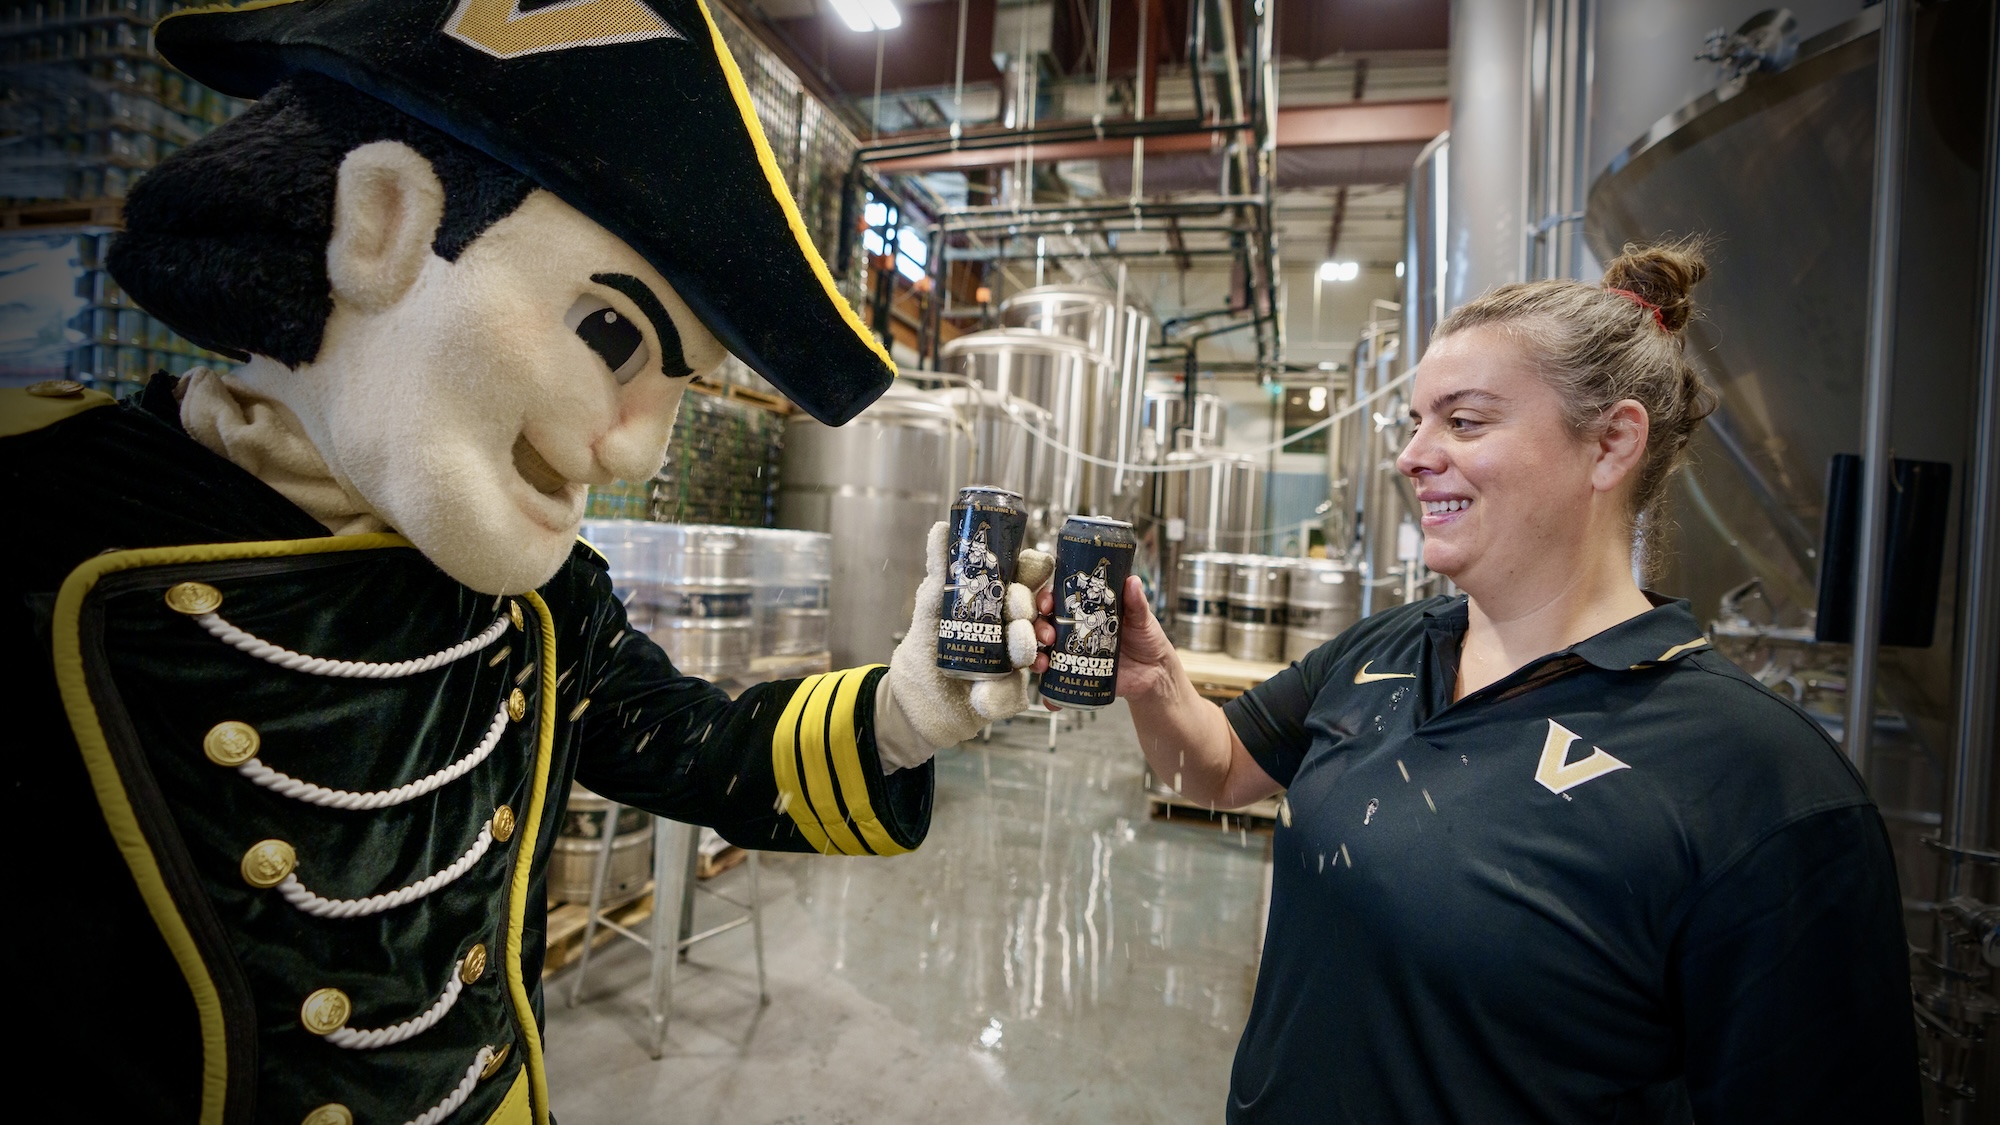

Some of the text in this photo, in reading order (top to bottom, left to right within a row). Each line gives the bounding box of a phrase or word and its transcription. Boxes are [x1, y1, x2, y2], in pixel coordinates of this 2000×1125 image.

[940, 619, 1002, 635] CONQUER
[956, 631, 1002, 643] PREVAIL
[947, 643, 985, 654] PALE ALE
[1050, 650, 1115, 669] CONQUER
[1049, 660, 1114, 677] AND PREVAIL
[1059, 675, 1100, 688] PALE ALE
[1054, 685, 1068, 694] ALC.
[1534, 718, 1632, 795] V
